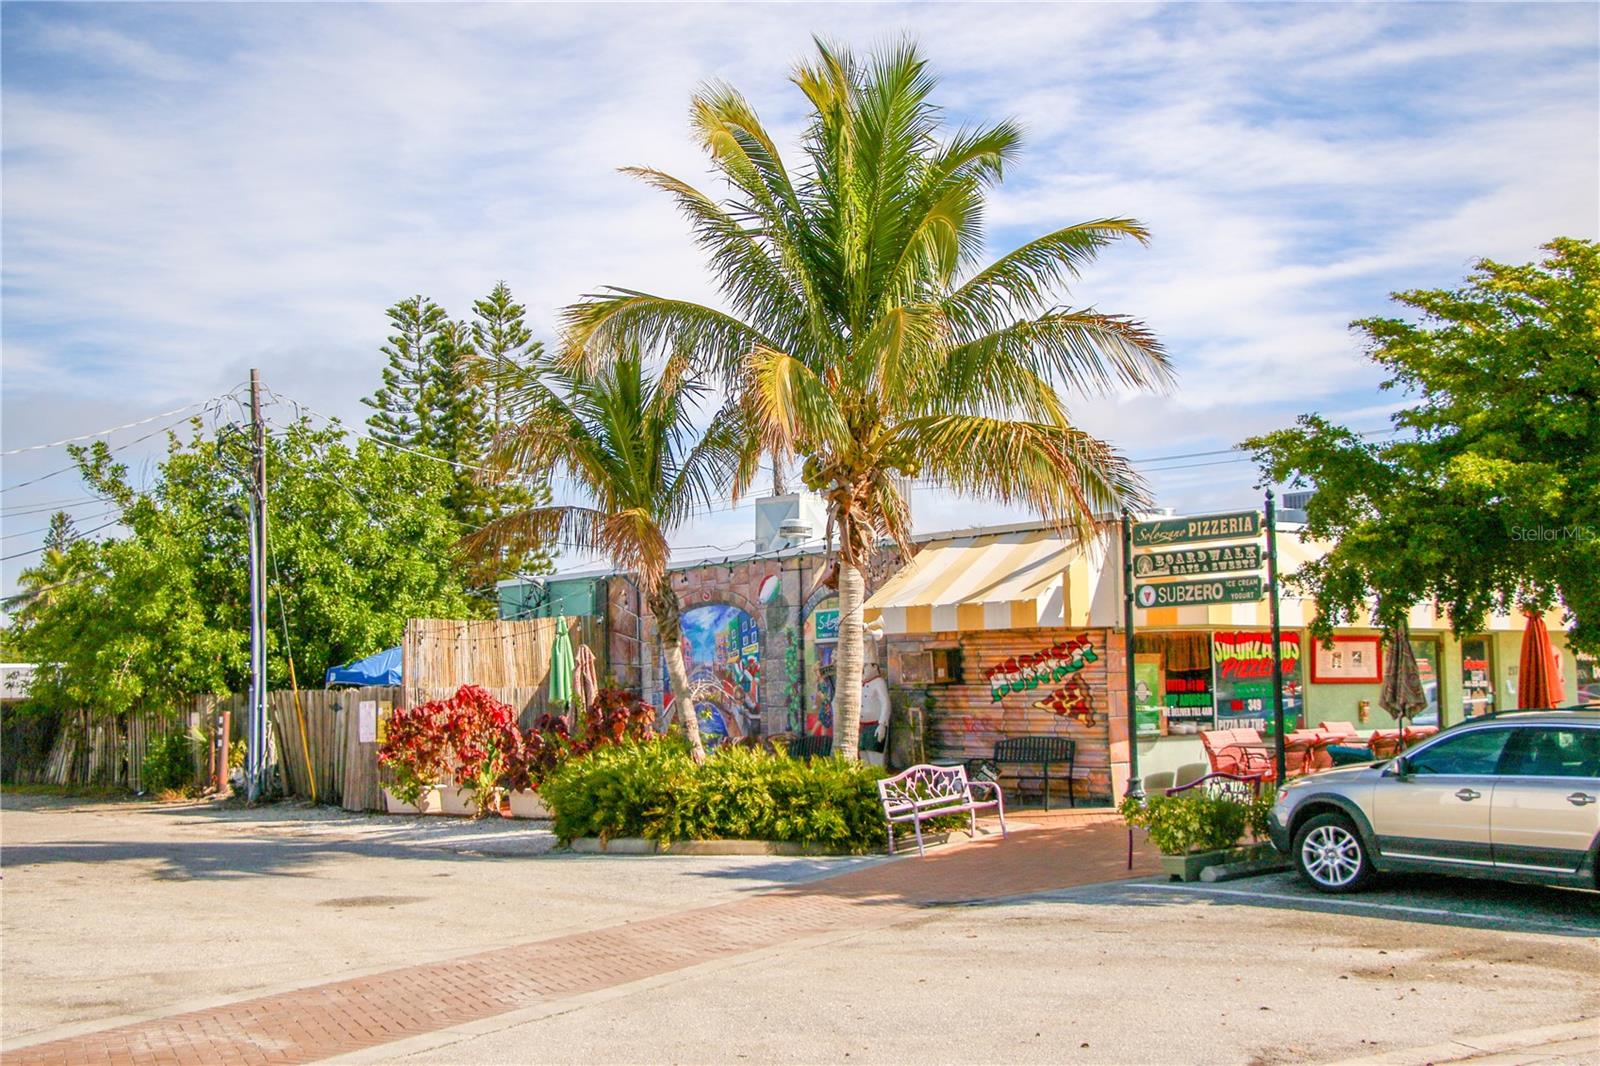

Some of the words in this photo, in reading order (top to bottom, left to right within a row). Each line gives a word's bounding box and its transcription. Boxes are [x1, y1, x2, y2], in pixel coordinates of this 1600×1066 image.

[1188, 516, 1253, 537] PIZZERIA
[1154, 545, 1257, 567] BOARDWALK
[1211, 559, 1256, 571] SWEETS
[1225, 580, 1236, 588] ICE
[1237, 578, 1258, 587] CREAM
[1158, 583, 1224, 603] SUBZERO
[1230, 592, 1254, 601] YOGURT
